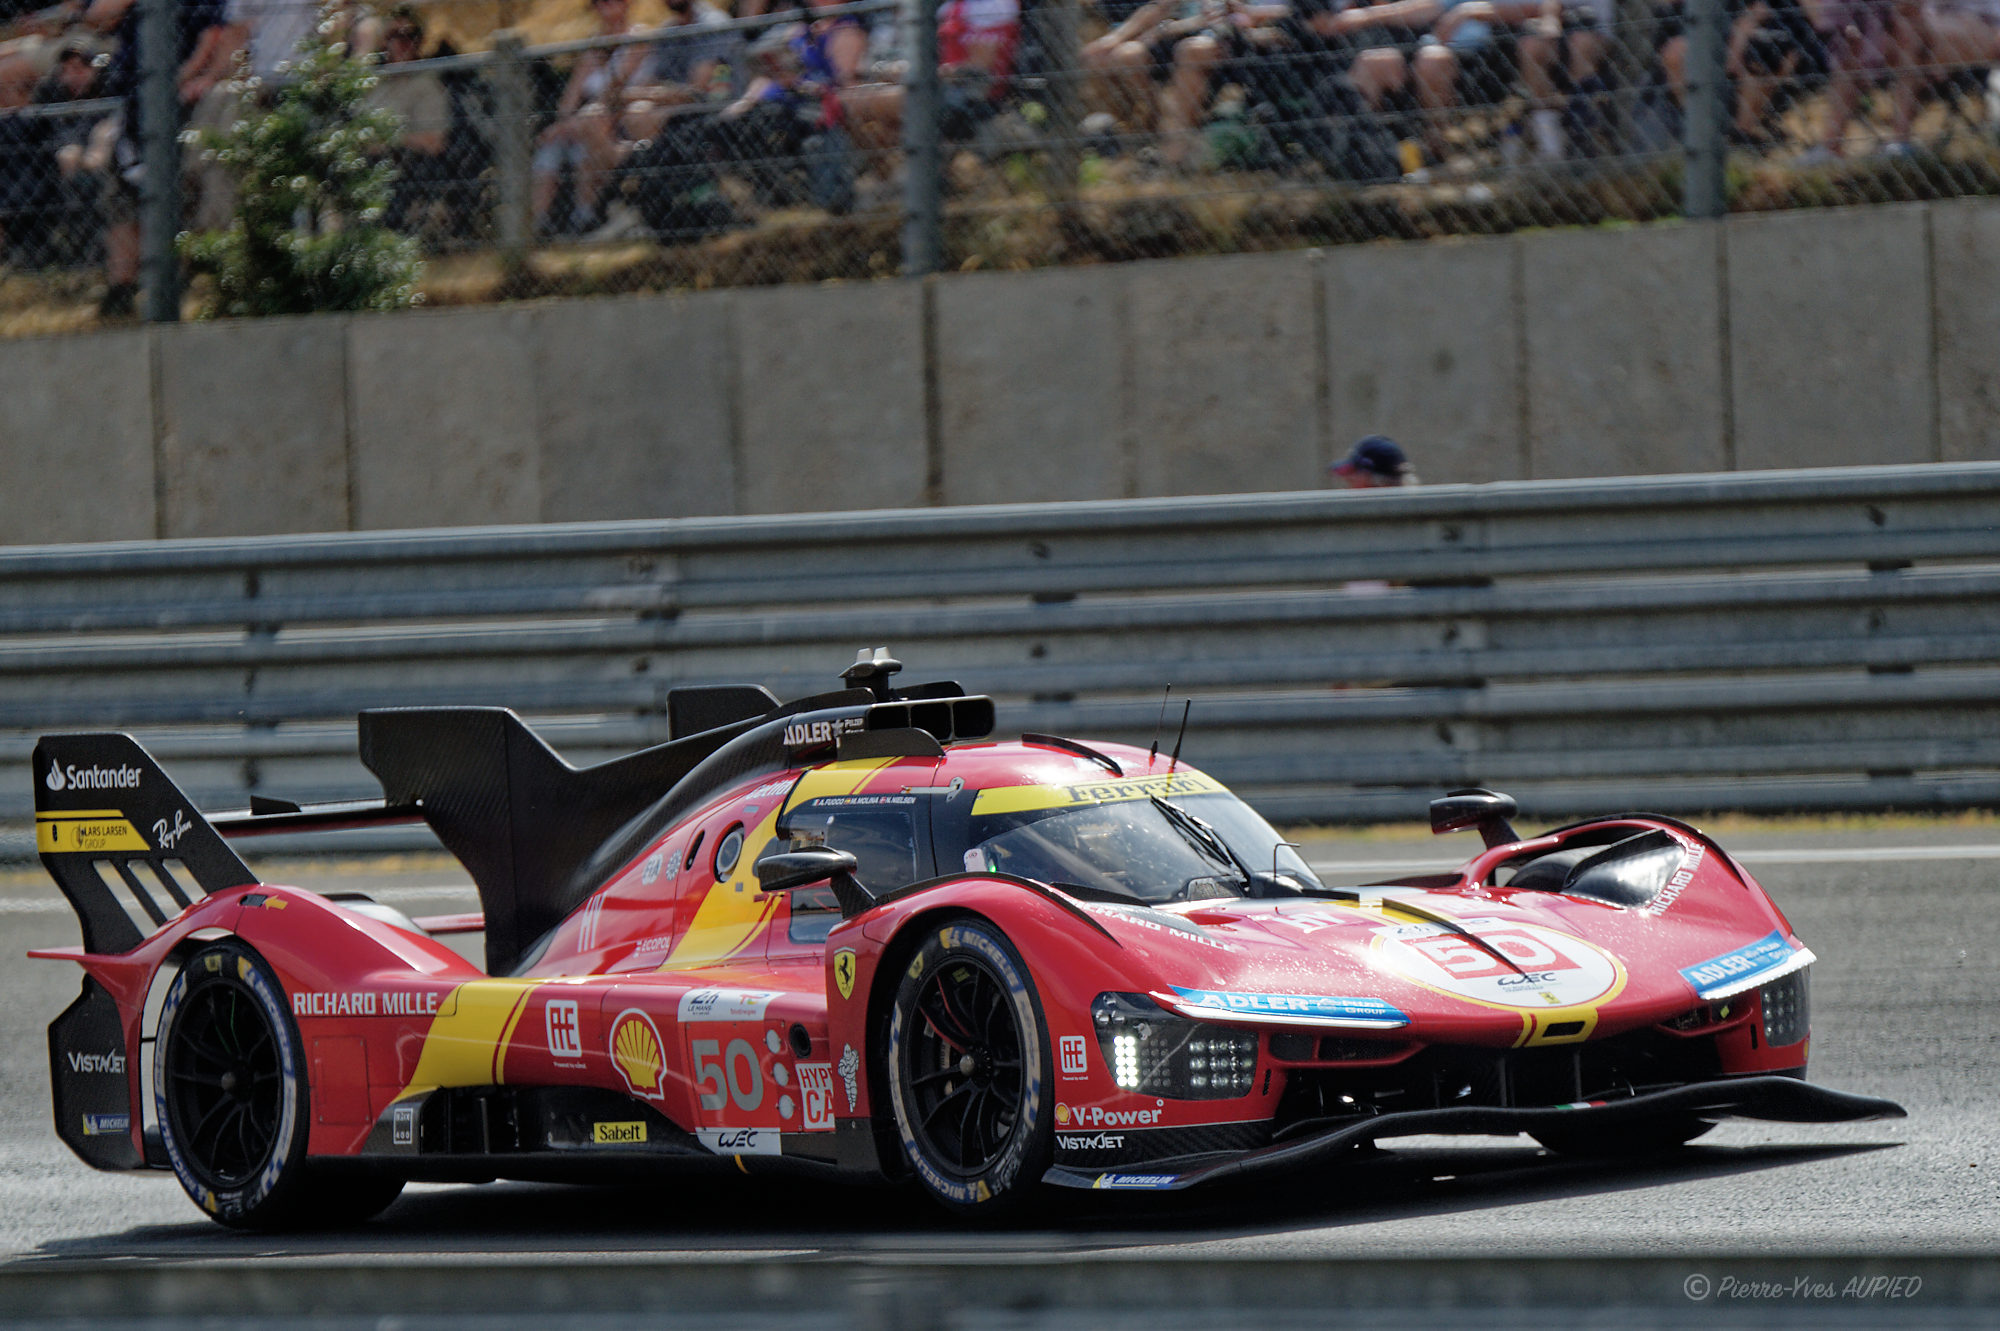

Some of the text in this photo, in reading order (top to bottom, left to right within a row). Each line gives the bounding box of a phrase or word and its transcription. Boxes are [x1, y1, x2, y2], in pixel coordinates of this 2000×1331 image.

[783, 721, 832, 746] ADLER
[66, 763, 142, 790] Santander
[1066, 775, 1210, 803] Ferrari
[102, 825, 128, 836] LARSEN
[1648, 867, 1695, 916] RICHARD
[962, 929, 1021, 988] MICHELIN
[1412, 933, 1558, 974] 50
[1497, 972, 1557, 987] WEC
[1690, 954, 1758, 986] ADLER
[293, 992, 438, 1015] RICHARD MILLE
[1200, 993, 1310, 1012] ADLER
[1345, 1006, 1386, 1016] GROUP
[692, 1038, 764, 1112] 50
[99, 1118, 129, 1129] MICHELIN
[1072, 1106, 1162, 1127] V-Power
[599, 1124, 641, 1141] Sabelt
[718, 1130, 759, 1148] WEC
[910, 1147, 966, 1201] MICHELIN
[1115, 1176, 1174, 1185] MICHELIN
